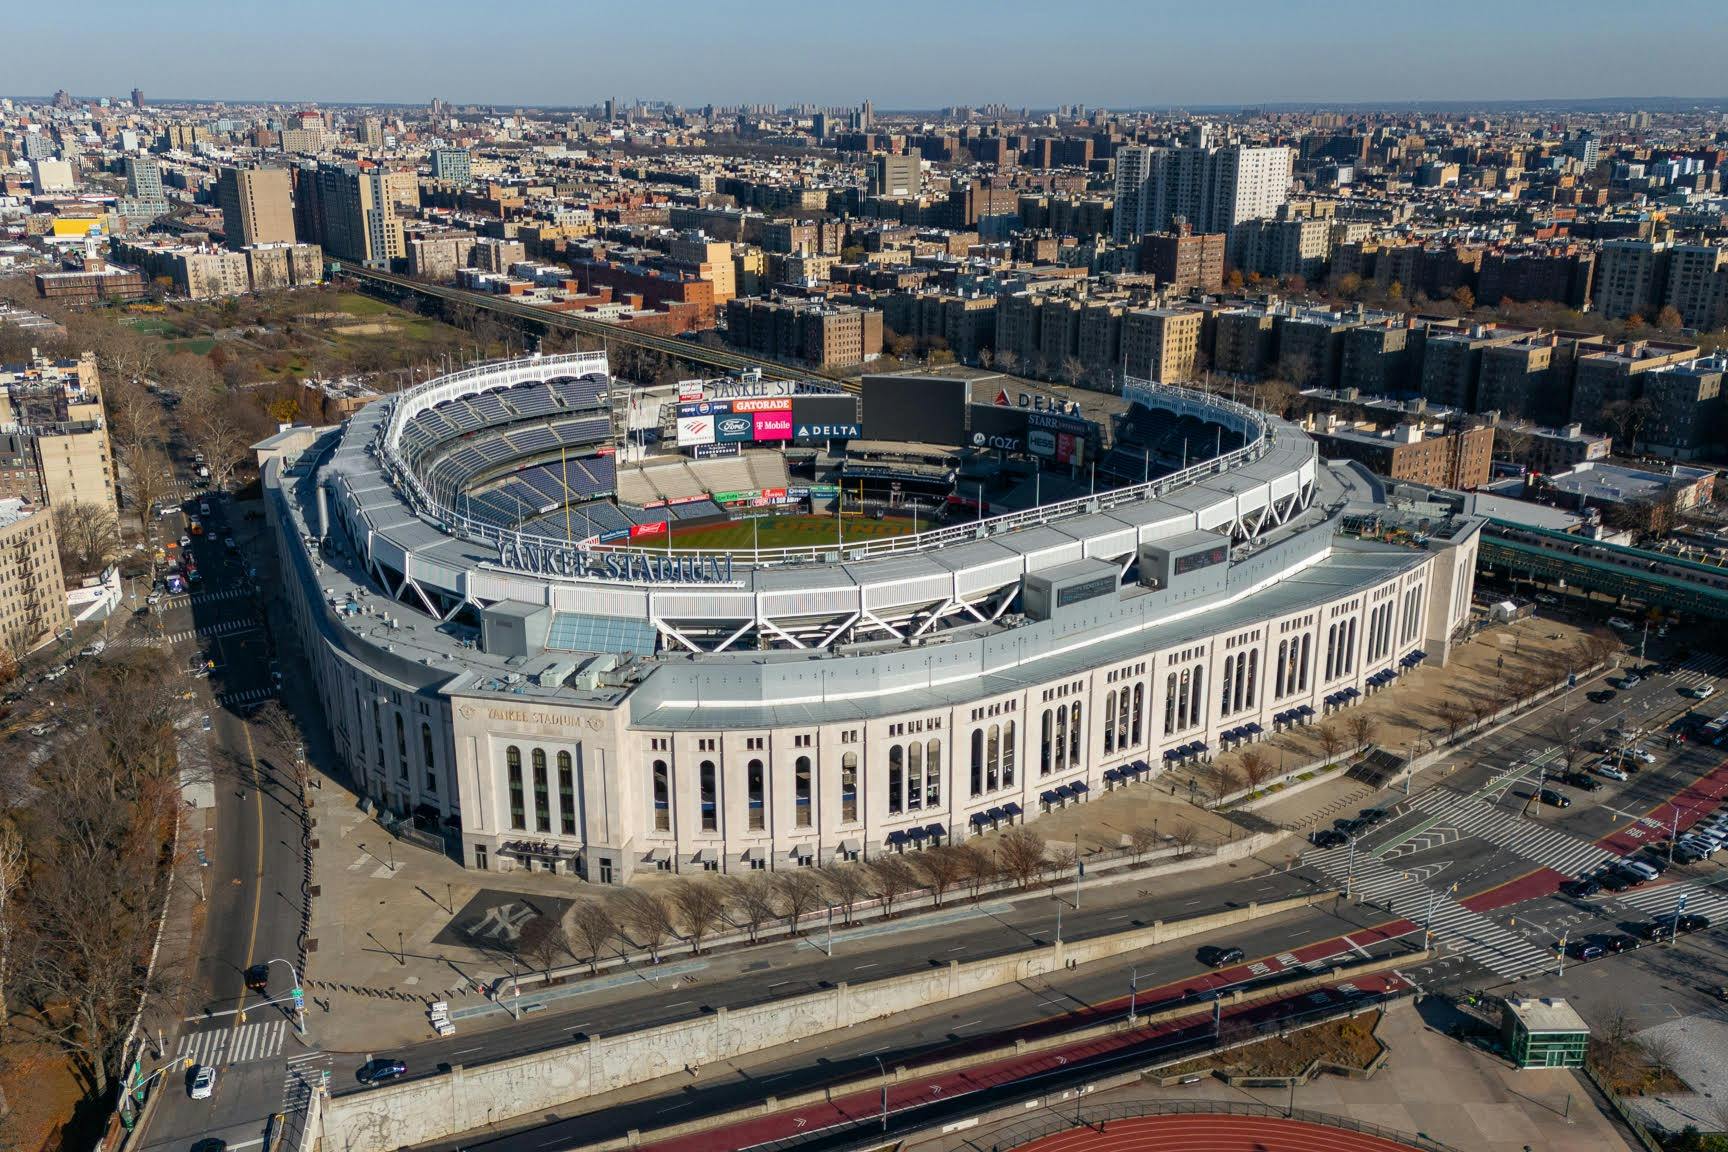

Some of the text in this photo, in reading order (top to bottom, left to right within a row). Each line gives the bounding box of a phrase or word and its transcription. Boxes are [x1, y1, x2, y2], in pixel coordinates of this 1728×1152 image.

[711, 381, 768, 399] YANKEE
[736, 400, 790, 412] GATORADE
[1018, 393, 1081, 419] DELTA
[722, 420, 746, 431] Ford
[765, 420, 791, 430] Mobile
[1028, 415, 1057, 429] STARR
[812, 425, 858, 436] DELTA
[988, 435, 1020, 450] razr
[494, 540, 592, 577] YANKEE
[605, 551, 733, 582] STADIUM
[487, 708, 581, 727] YANKEE STADIUM
